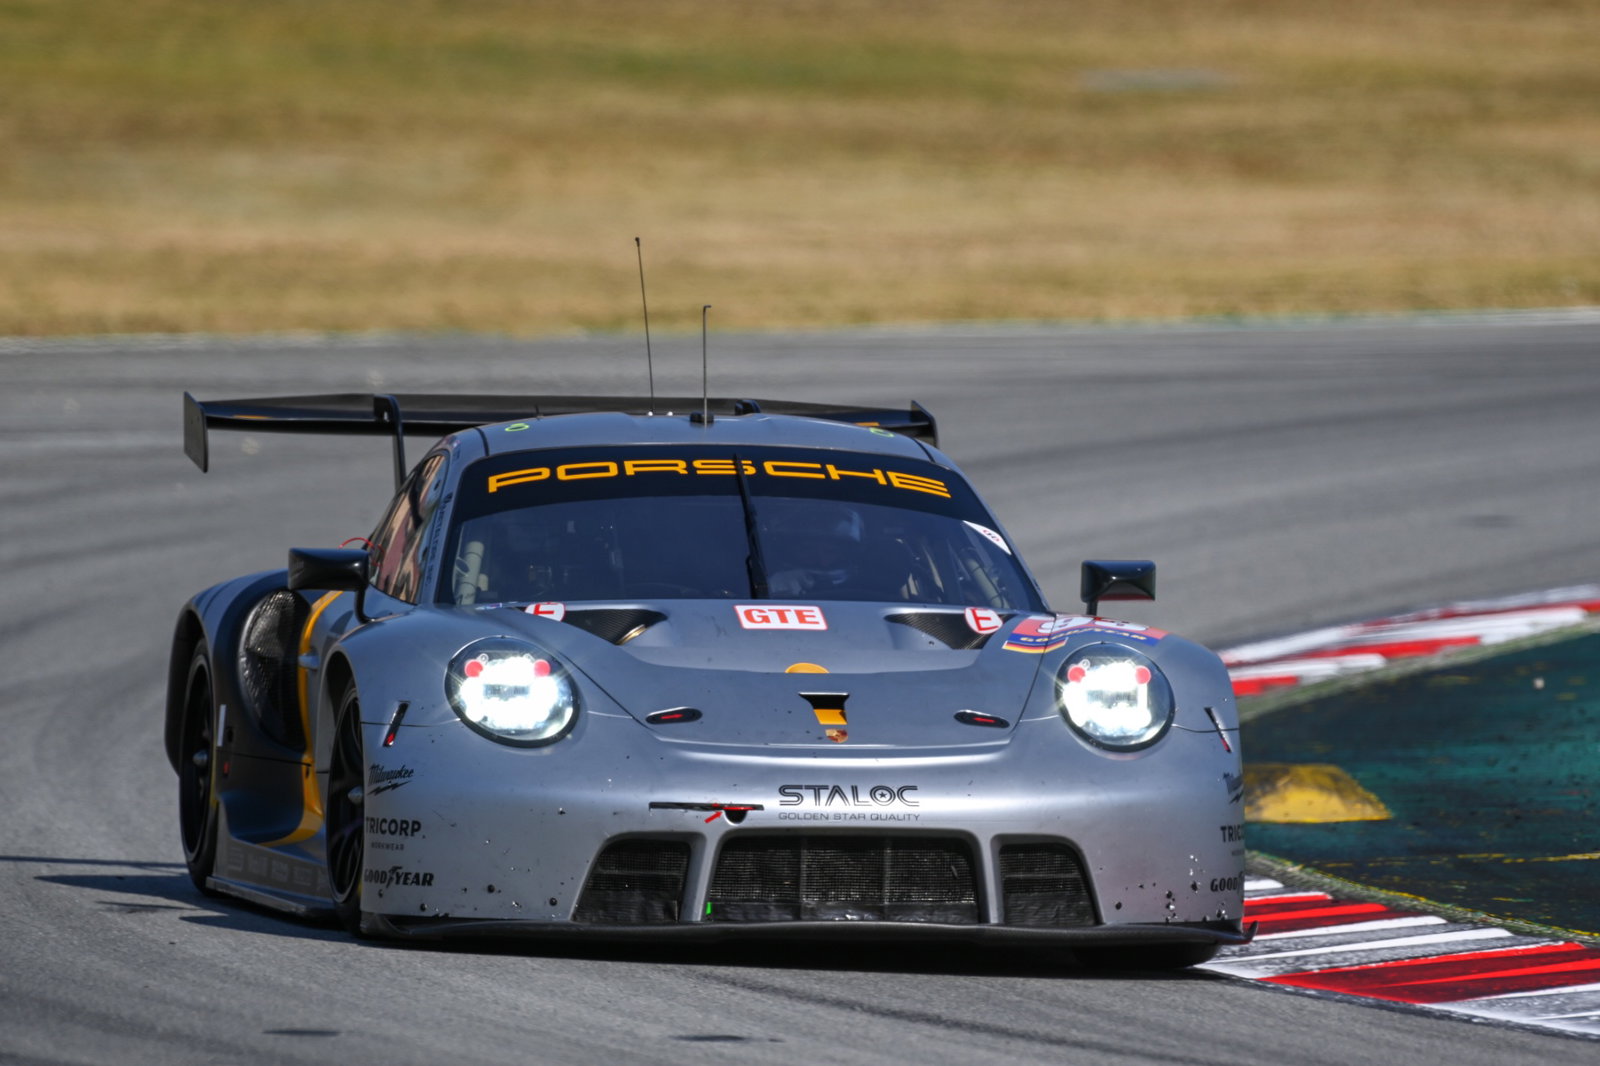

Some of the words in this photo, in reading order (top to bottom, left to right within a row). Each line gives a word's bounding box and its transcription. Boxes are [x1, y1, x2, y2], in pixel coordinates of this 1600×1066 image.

[488, 459, 951, 498] PORSCHE
[744, 608, 821, 626] GTE
[971, 608, 998, 632] E
[778, 784, 920, 807] STALOC
[366, 817, 421, 837] TRICORP
[778, 812, 829, 821] GOLDEN
[833, 812, 866, 821] STAR
[870, 813, 920, 822] QUALITY
[364, 866, 434, 888] GOODYEAR
